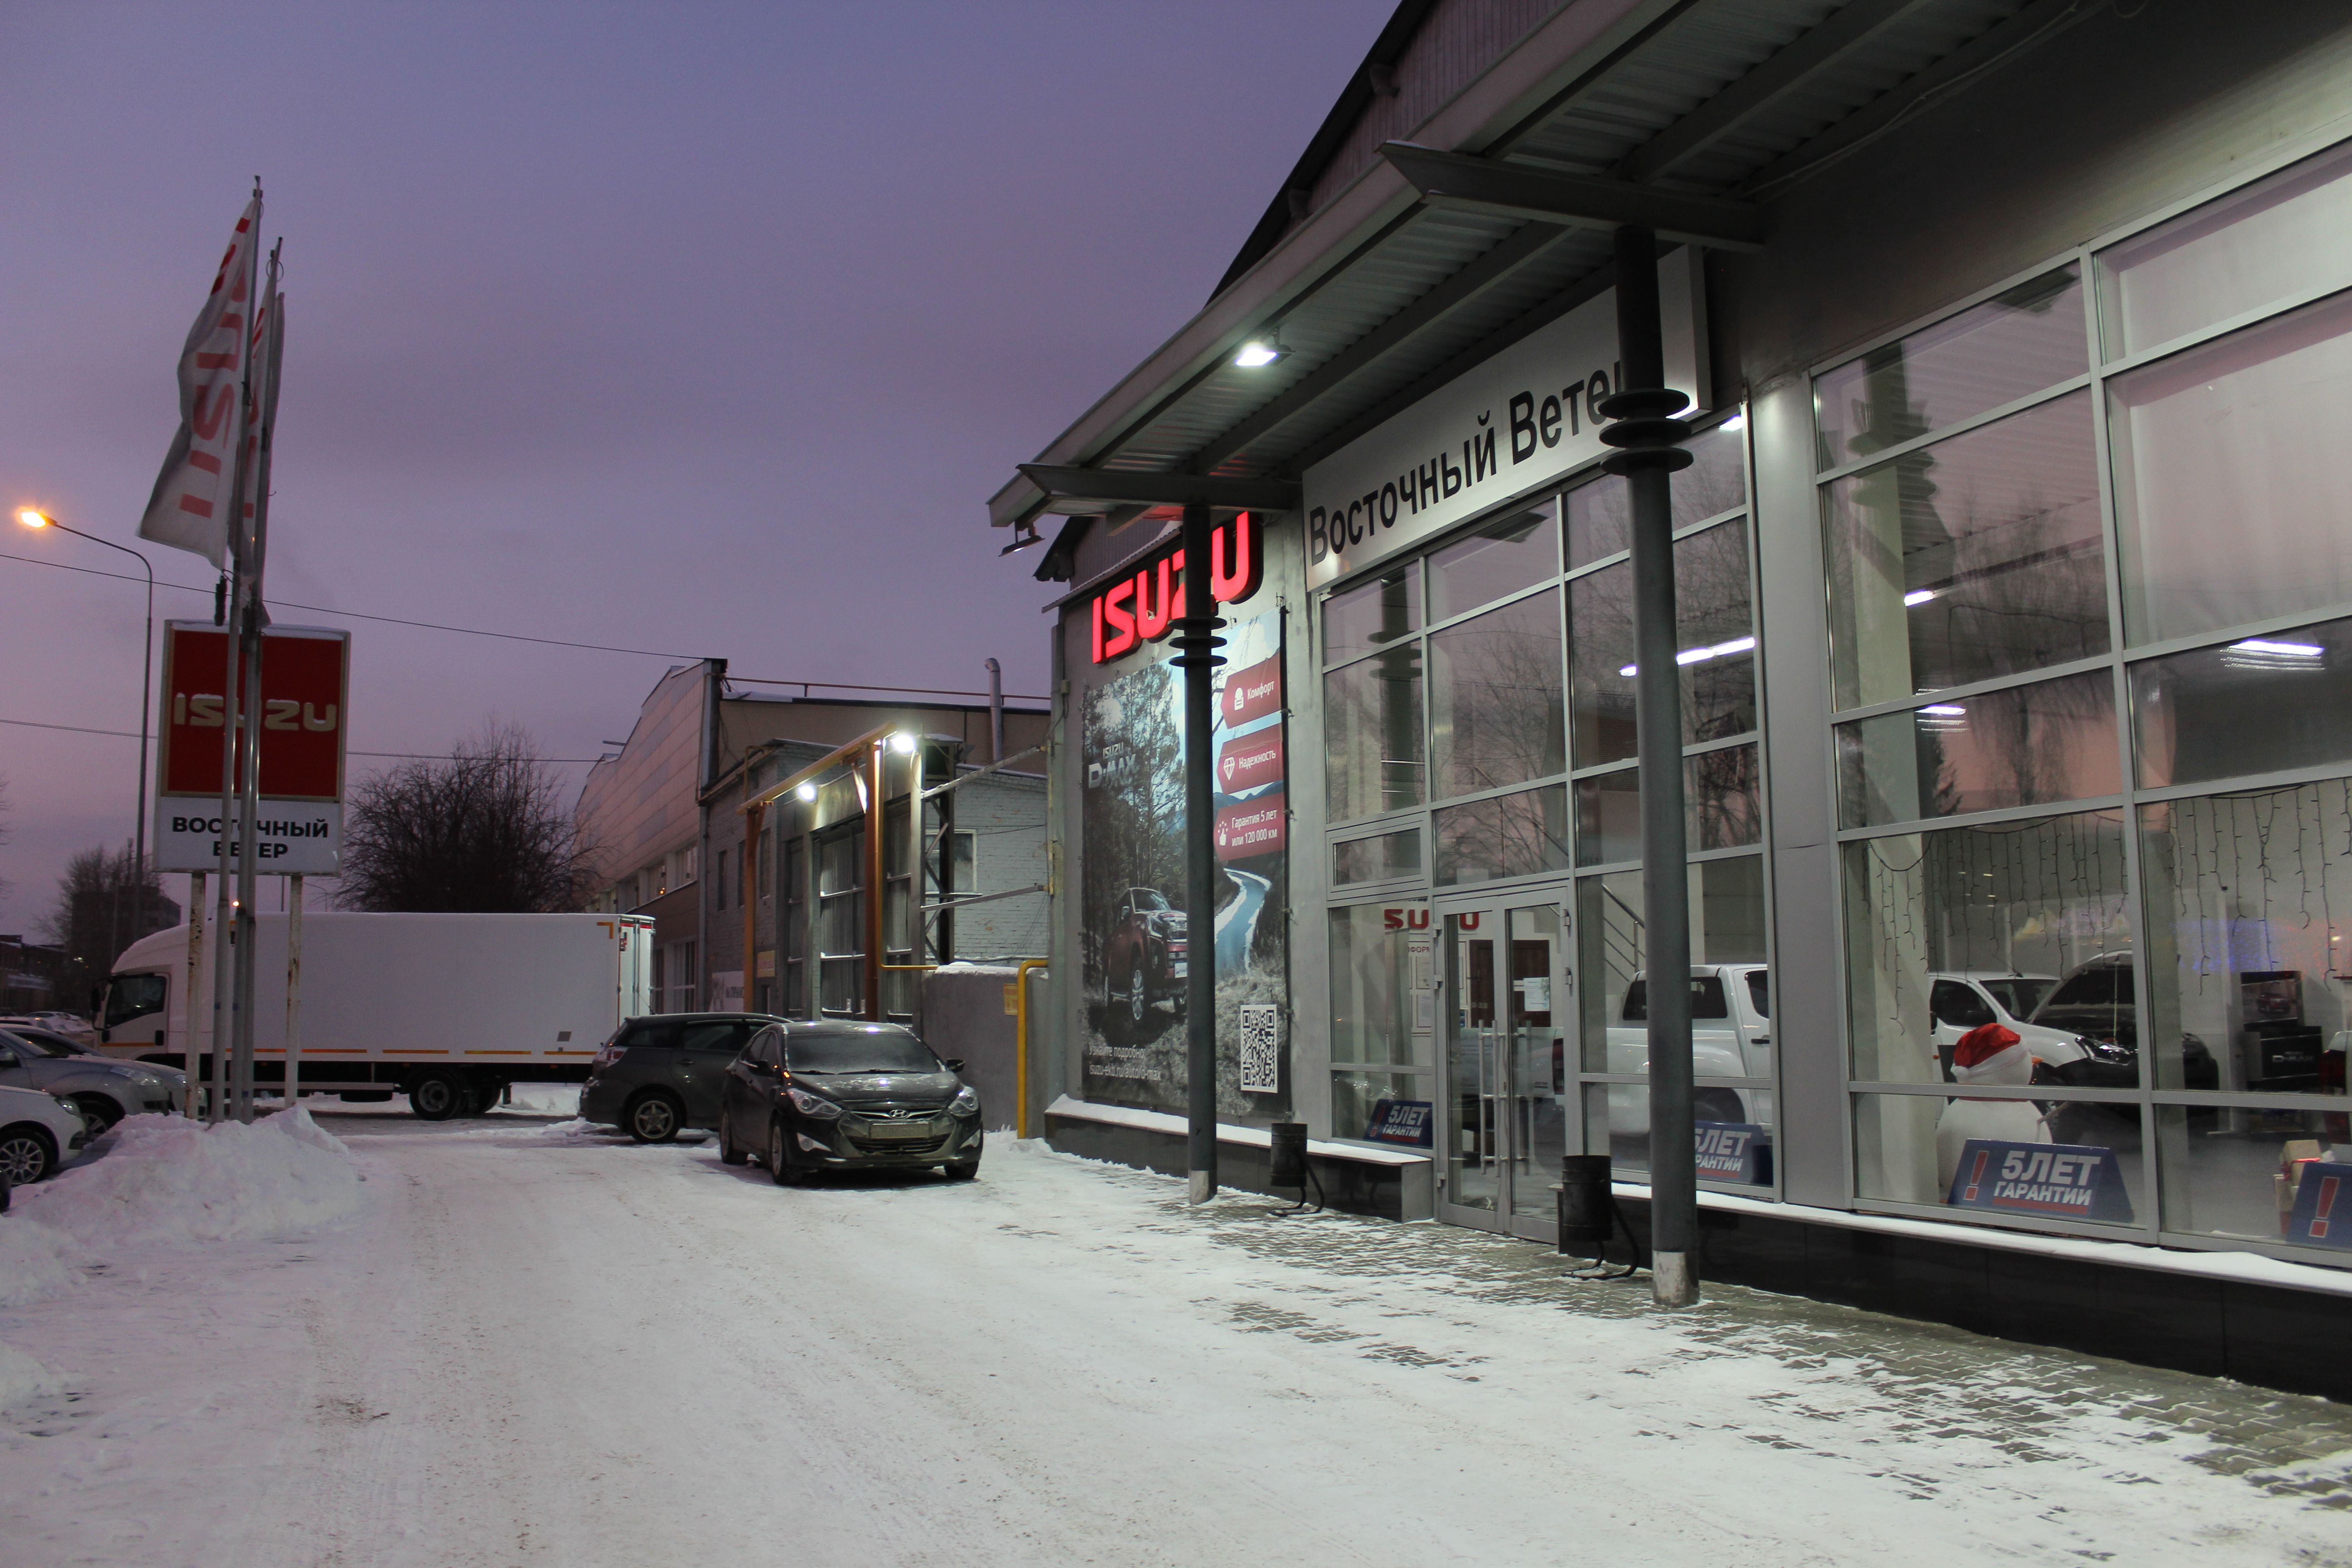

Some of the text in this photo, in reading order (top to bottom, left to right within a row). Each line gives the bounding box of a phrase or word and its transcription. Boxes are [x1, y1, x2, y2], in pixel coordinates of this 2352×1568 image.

[1309, 359, 1621, 566] Восточный Вете
[1093, 511, 1251, 664] ISUU
[1247, 681, 1274, 700] Комфорт
[173, 692, 337, 732] ISZU
[1103, 741, 1124, 760] ISUZU
[1239, 750, 1276, 769] Надежность
[1088, 753, 1137, 789] D-MAX
[172, 816, 328, 838] ВОСЧНЫЙ
[1231, 809, 1278, 831] Гарантия 5 лет
[1231, 828, 1278, 847] или 120 000 км
[213, 841, 288, 858] ВЕЕР
[1382, 1124, 1422, 1137] ГАРАНТИИ
[1695, 1154, 1744, 1172] РАНТИИ
[1993, 1181, 2093, 1205] ГАРАНТИИ
